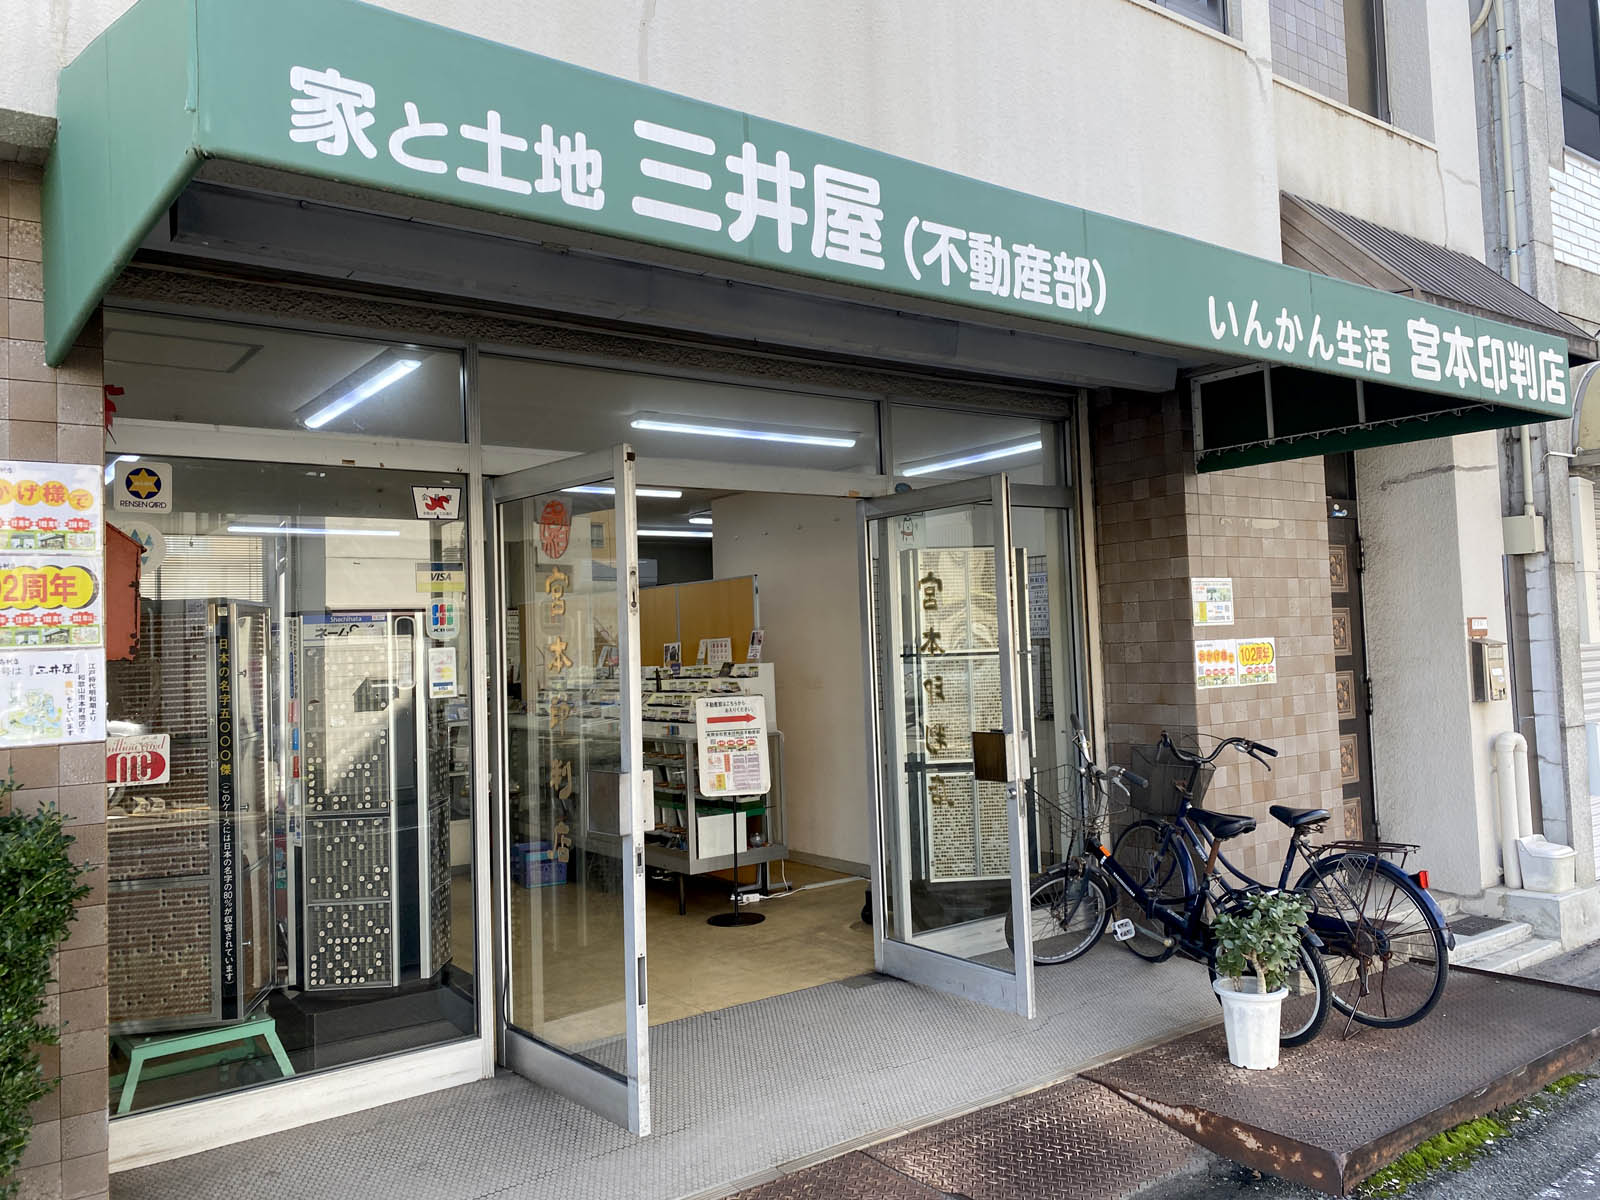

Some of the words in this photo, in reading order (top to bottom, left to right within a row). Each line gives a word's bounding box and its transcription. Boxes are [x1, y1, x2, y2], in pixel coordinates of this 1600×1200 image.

[289, 65, 605, 211] 家と土地
[632, 119, 885, 270] 三井屋
[904, 216, 1107, 315] （不動産部）
[1208, 295, 1391, 375] いんかん生活
[1407, 317, 1567, 405] 宮本印判店
[119, 500, 147, 508] RENSEN
[0, 573, 77, 603] 2周年
[431, 573, 452, 581] VISA
[545, 566, 573, 863] 宮本印判店
